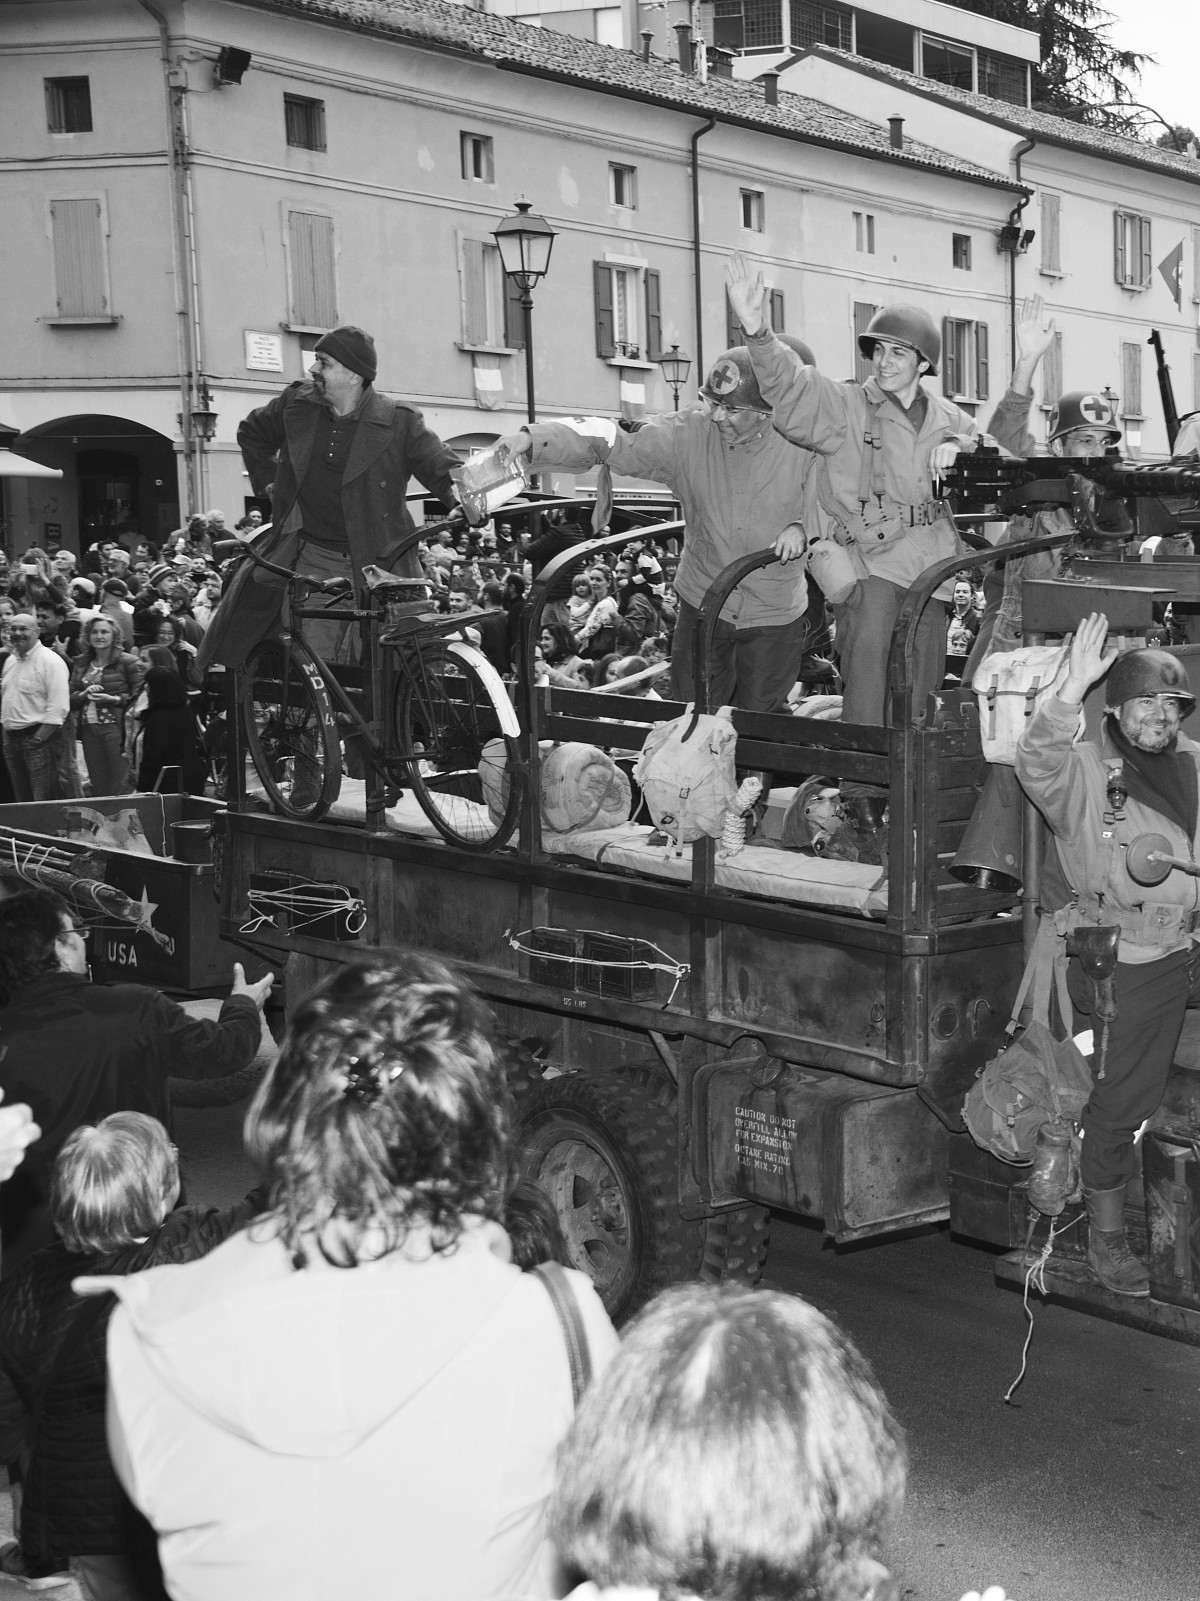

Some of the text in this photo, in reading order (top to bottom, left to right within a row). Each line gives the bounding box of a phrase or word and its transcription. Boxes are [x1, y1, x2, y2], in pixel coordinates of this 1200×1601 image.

[108, 940, 138, 968] USA
[735, 1106, 766, 1122] CAUTION
[769, 1114, 780, 1125] DO
[734, 1117, 771, 1135] OVERFILL
[735, 1129, 793, 1151] FOR EXPANSION
[734, 1143, 763, 1159] OCTANE
